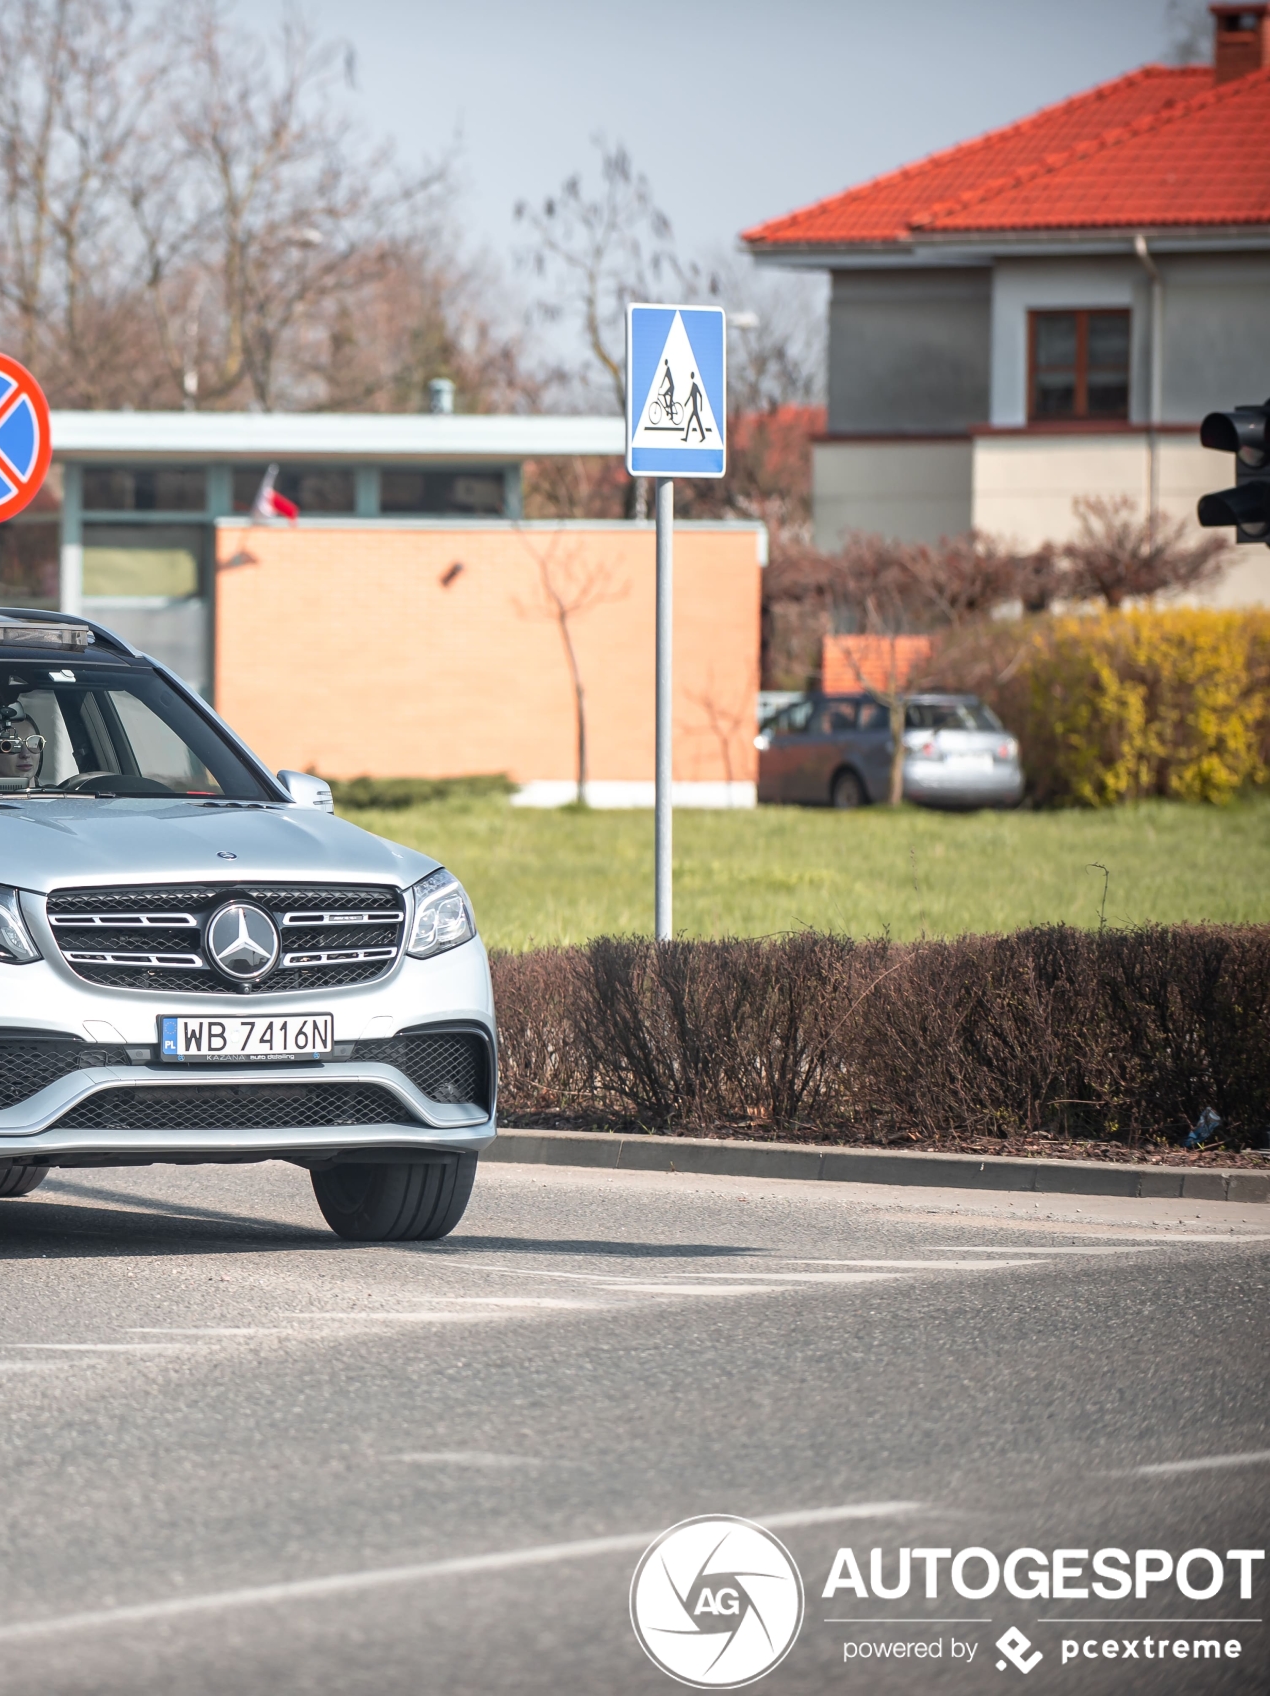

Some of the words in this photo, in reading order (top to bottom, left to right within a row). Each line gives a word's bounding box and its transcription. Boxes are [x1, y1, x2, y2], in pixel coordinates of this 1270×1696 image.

[164, 1040, 176, 1050] PL
[183, 1021, 228, 1052] WB
[240, 1019, 328, 1051] 7416N
